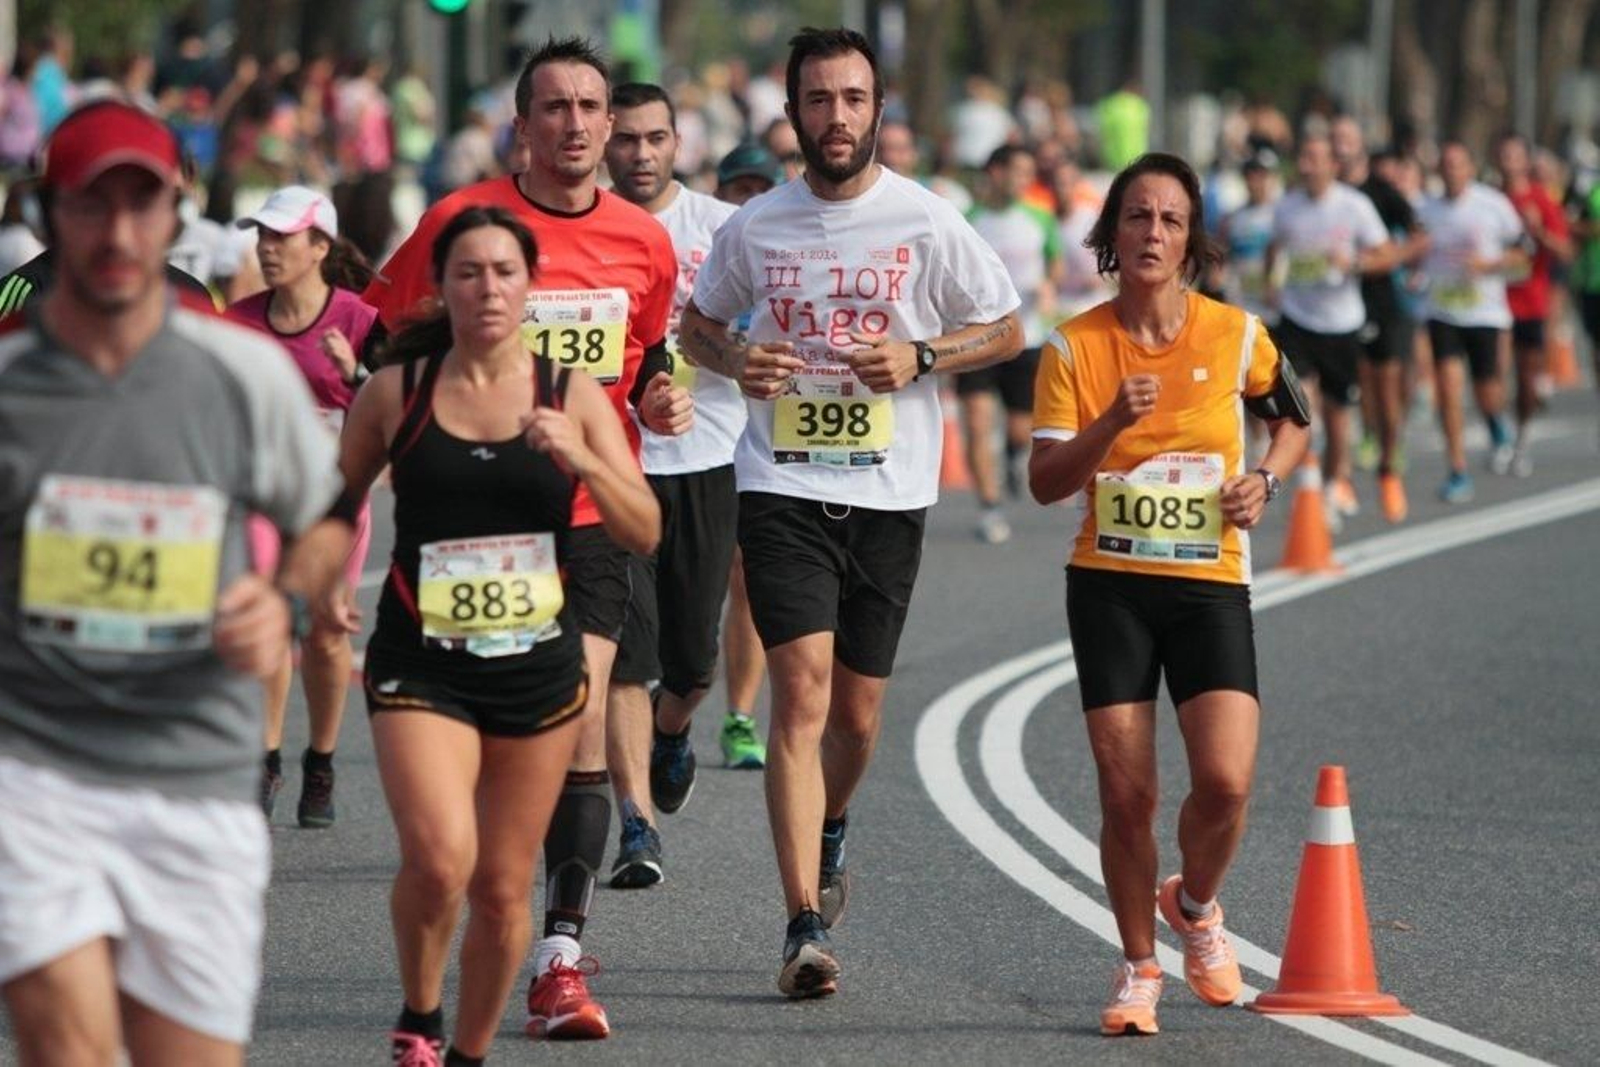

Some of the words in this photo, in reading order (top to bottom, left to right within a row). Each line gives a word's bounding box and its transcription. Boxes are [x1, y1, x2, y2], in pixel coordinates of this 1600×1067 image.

[764, 250, 777, 260] 28
[780, 250, 805, 262] Sept
[809, 250, 838, 260] 2014
[765, 266, 801, 288] III
[827, 267, 908, 302] 10K
[769, 297, 889, 347] Vigo
[535, 328, 605, 365] 138
[796, 402, 871, 437] 398
[1111, 493, 1206, 530] 1085
[87, 541, 158, 598] 94
[451, 579, 535, 621] 883
